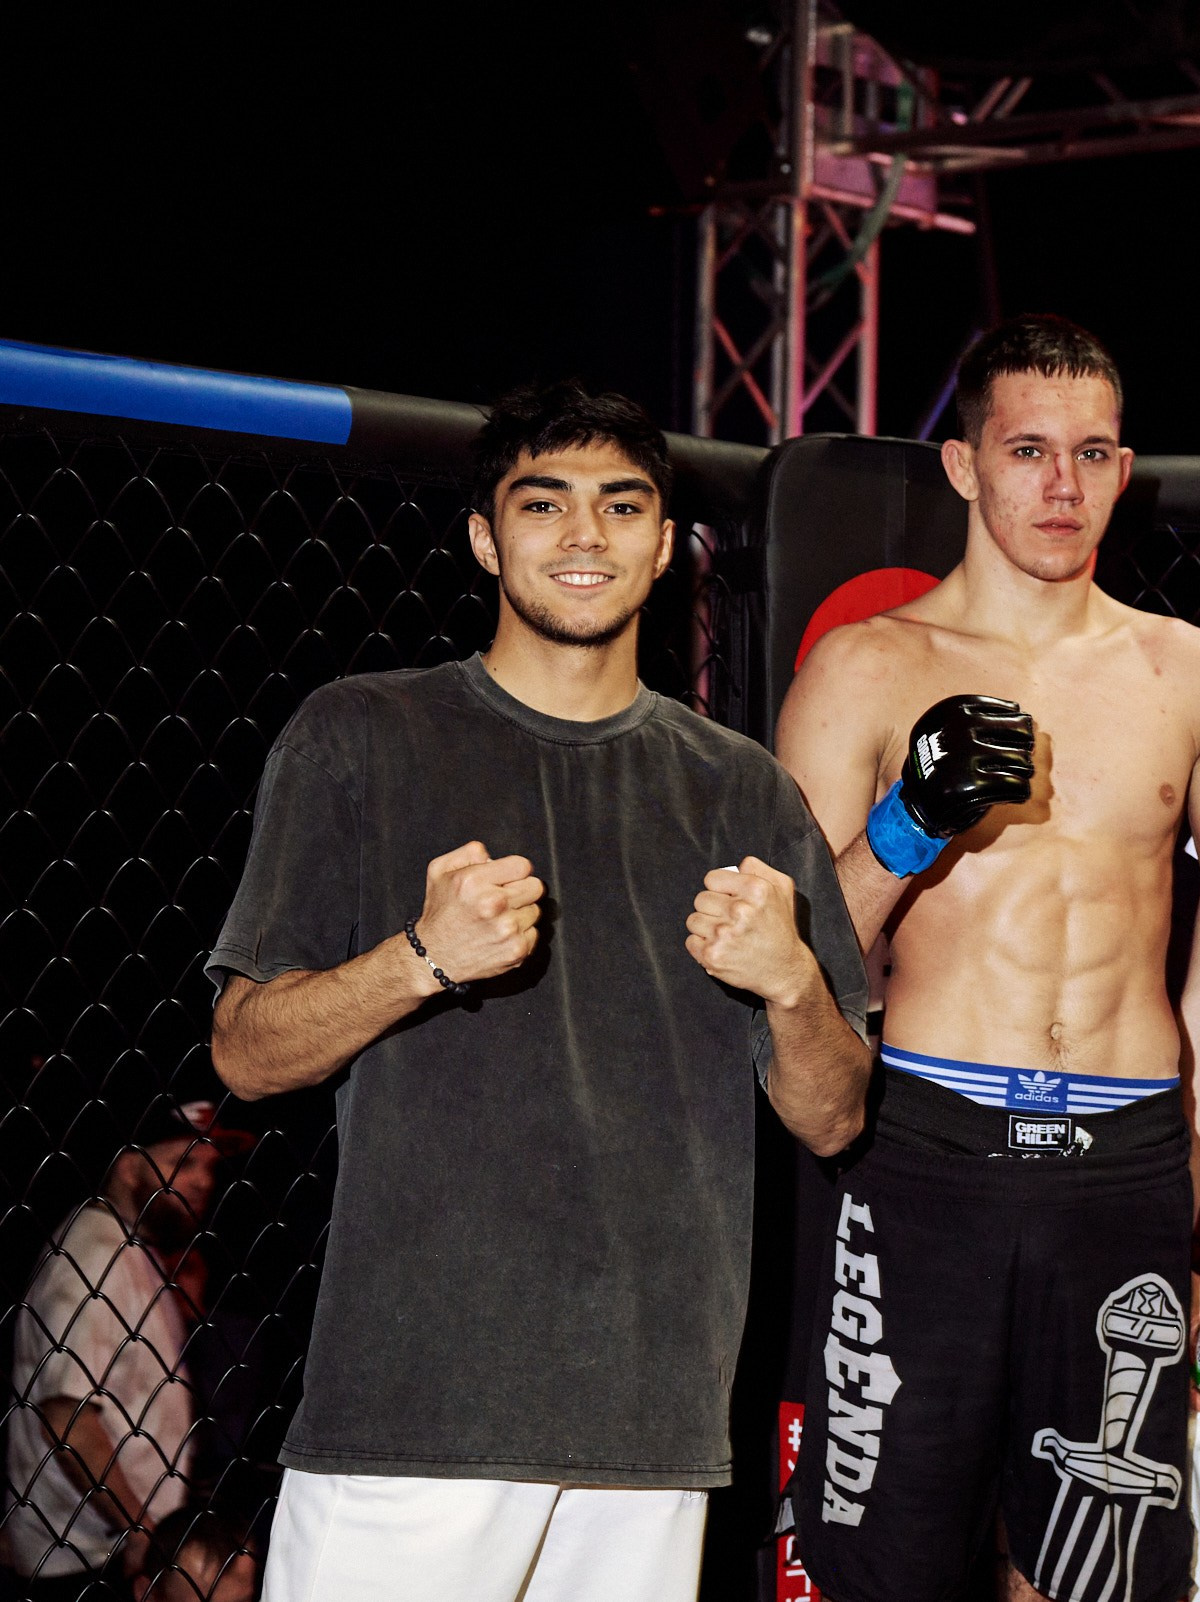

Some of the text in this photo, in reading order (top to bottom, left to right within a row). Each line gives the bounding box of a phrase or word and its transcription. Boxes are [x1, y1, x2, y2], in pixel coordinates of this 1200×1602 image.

[1015, 1092, 1059, 1103] adidas
[1015, 1122, 1065, 1134] GREEN
[822, 1193, 902, 1528] LEGENDA
